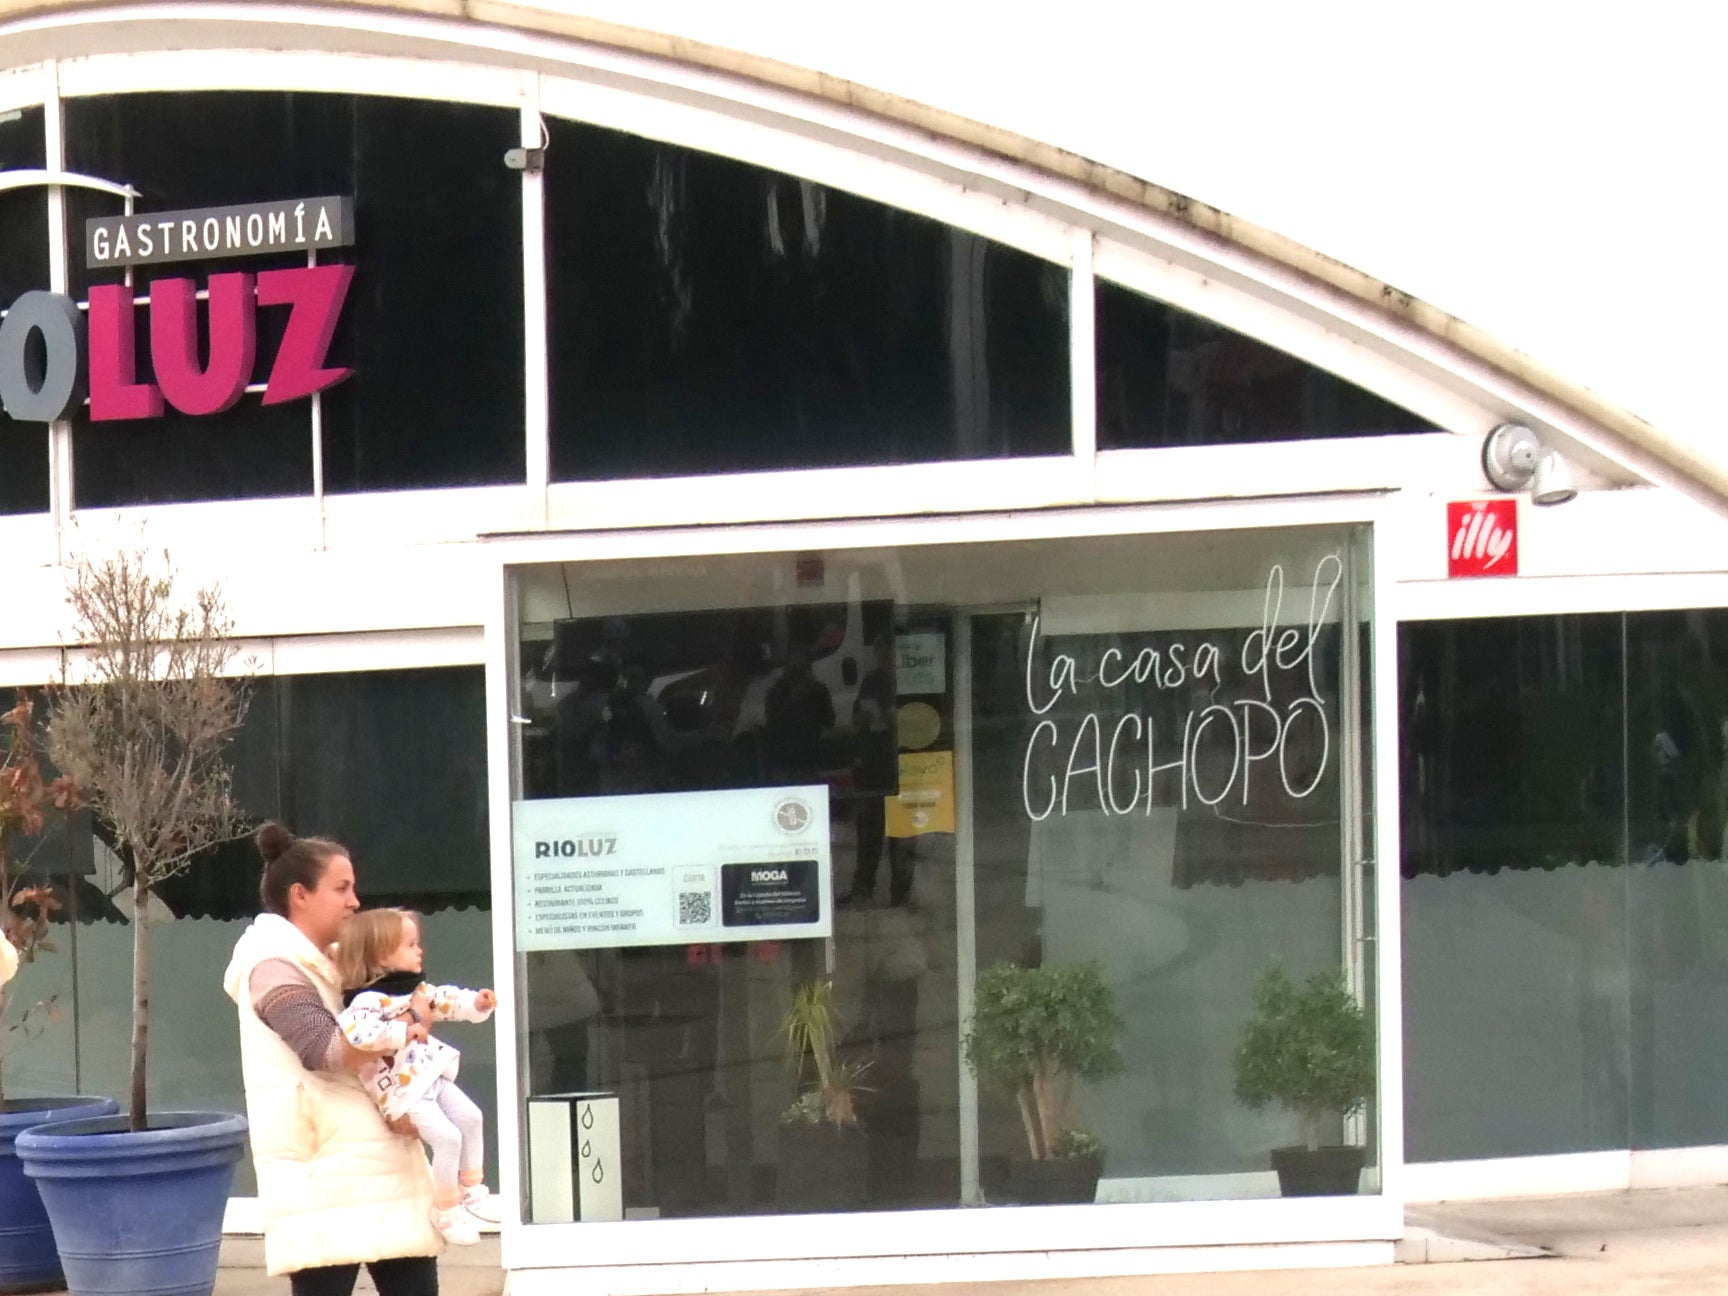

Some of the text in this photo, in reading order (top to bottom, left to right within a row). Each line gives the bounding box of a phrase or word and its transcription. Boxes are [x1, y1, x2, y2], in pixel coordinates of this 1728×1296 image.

[93, 204, 334, 262] GASTRONOMÍA
[1451, 511, 1513, 570] illy
[1025, 553, 1343, 715] la casa del
[1022, 697, 1330, 821] CACHOPO
[534, 837, 618, 859] RIOLUZ
